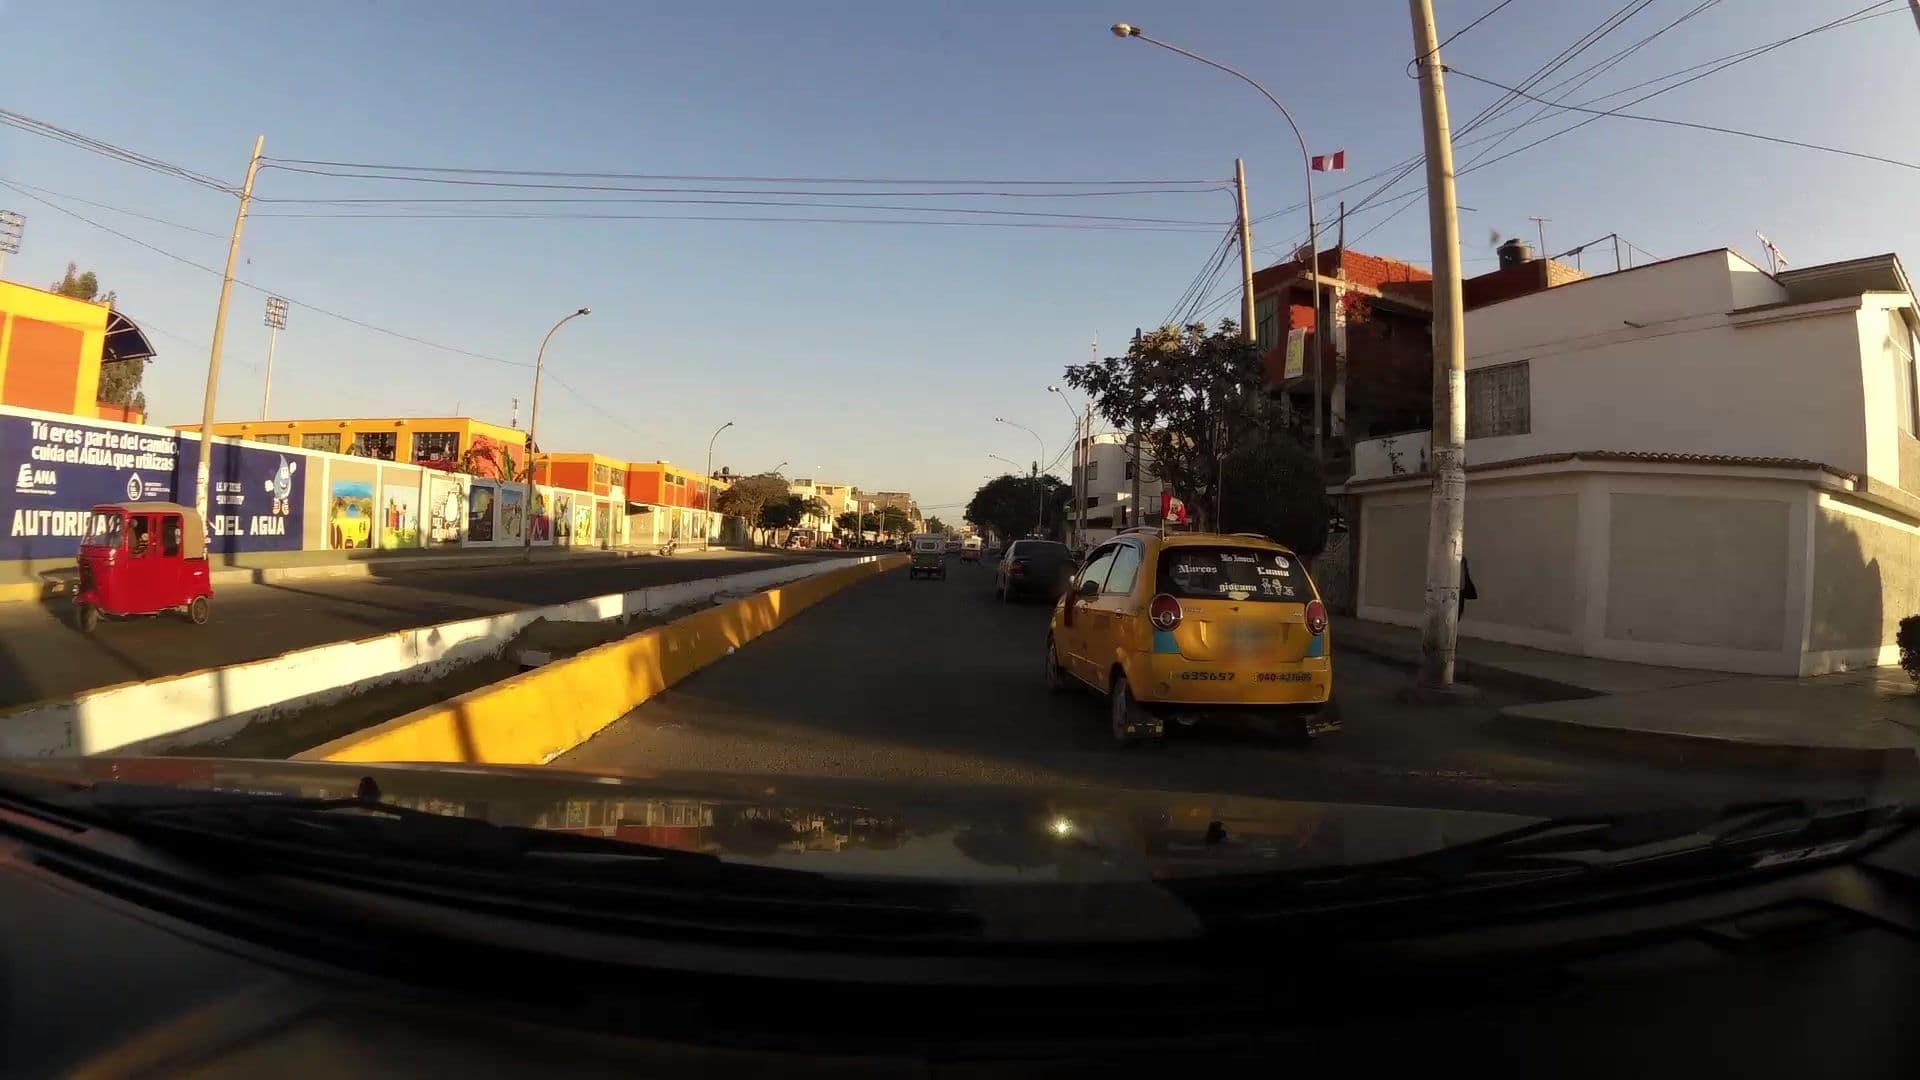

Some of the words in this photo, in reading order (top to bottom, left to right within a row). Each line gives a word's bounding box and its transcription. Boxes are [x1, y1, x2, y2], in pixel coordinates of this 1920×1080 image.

[50, 427, 82, 444] eres
[84, 431, 119, 449] parte
[120, 433, 138, 450] del
[32, 444, 65, 462] cuida
[66, 447, 79, 463] el
[79, 448, 112, 466] AGUA
[113, 453, 134, 470] que
[136, 453, 174, 471] utilizas
[34, 470, 57, 485] ANA
[215, 515, 244, 535] DEL
[250, 516, 285, 535] AGUA
[1178, 564, 1218, 574] Marcos
